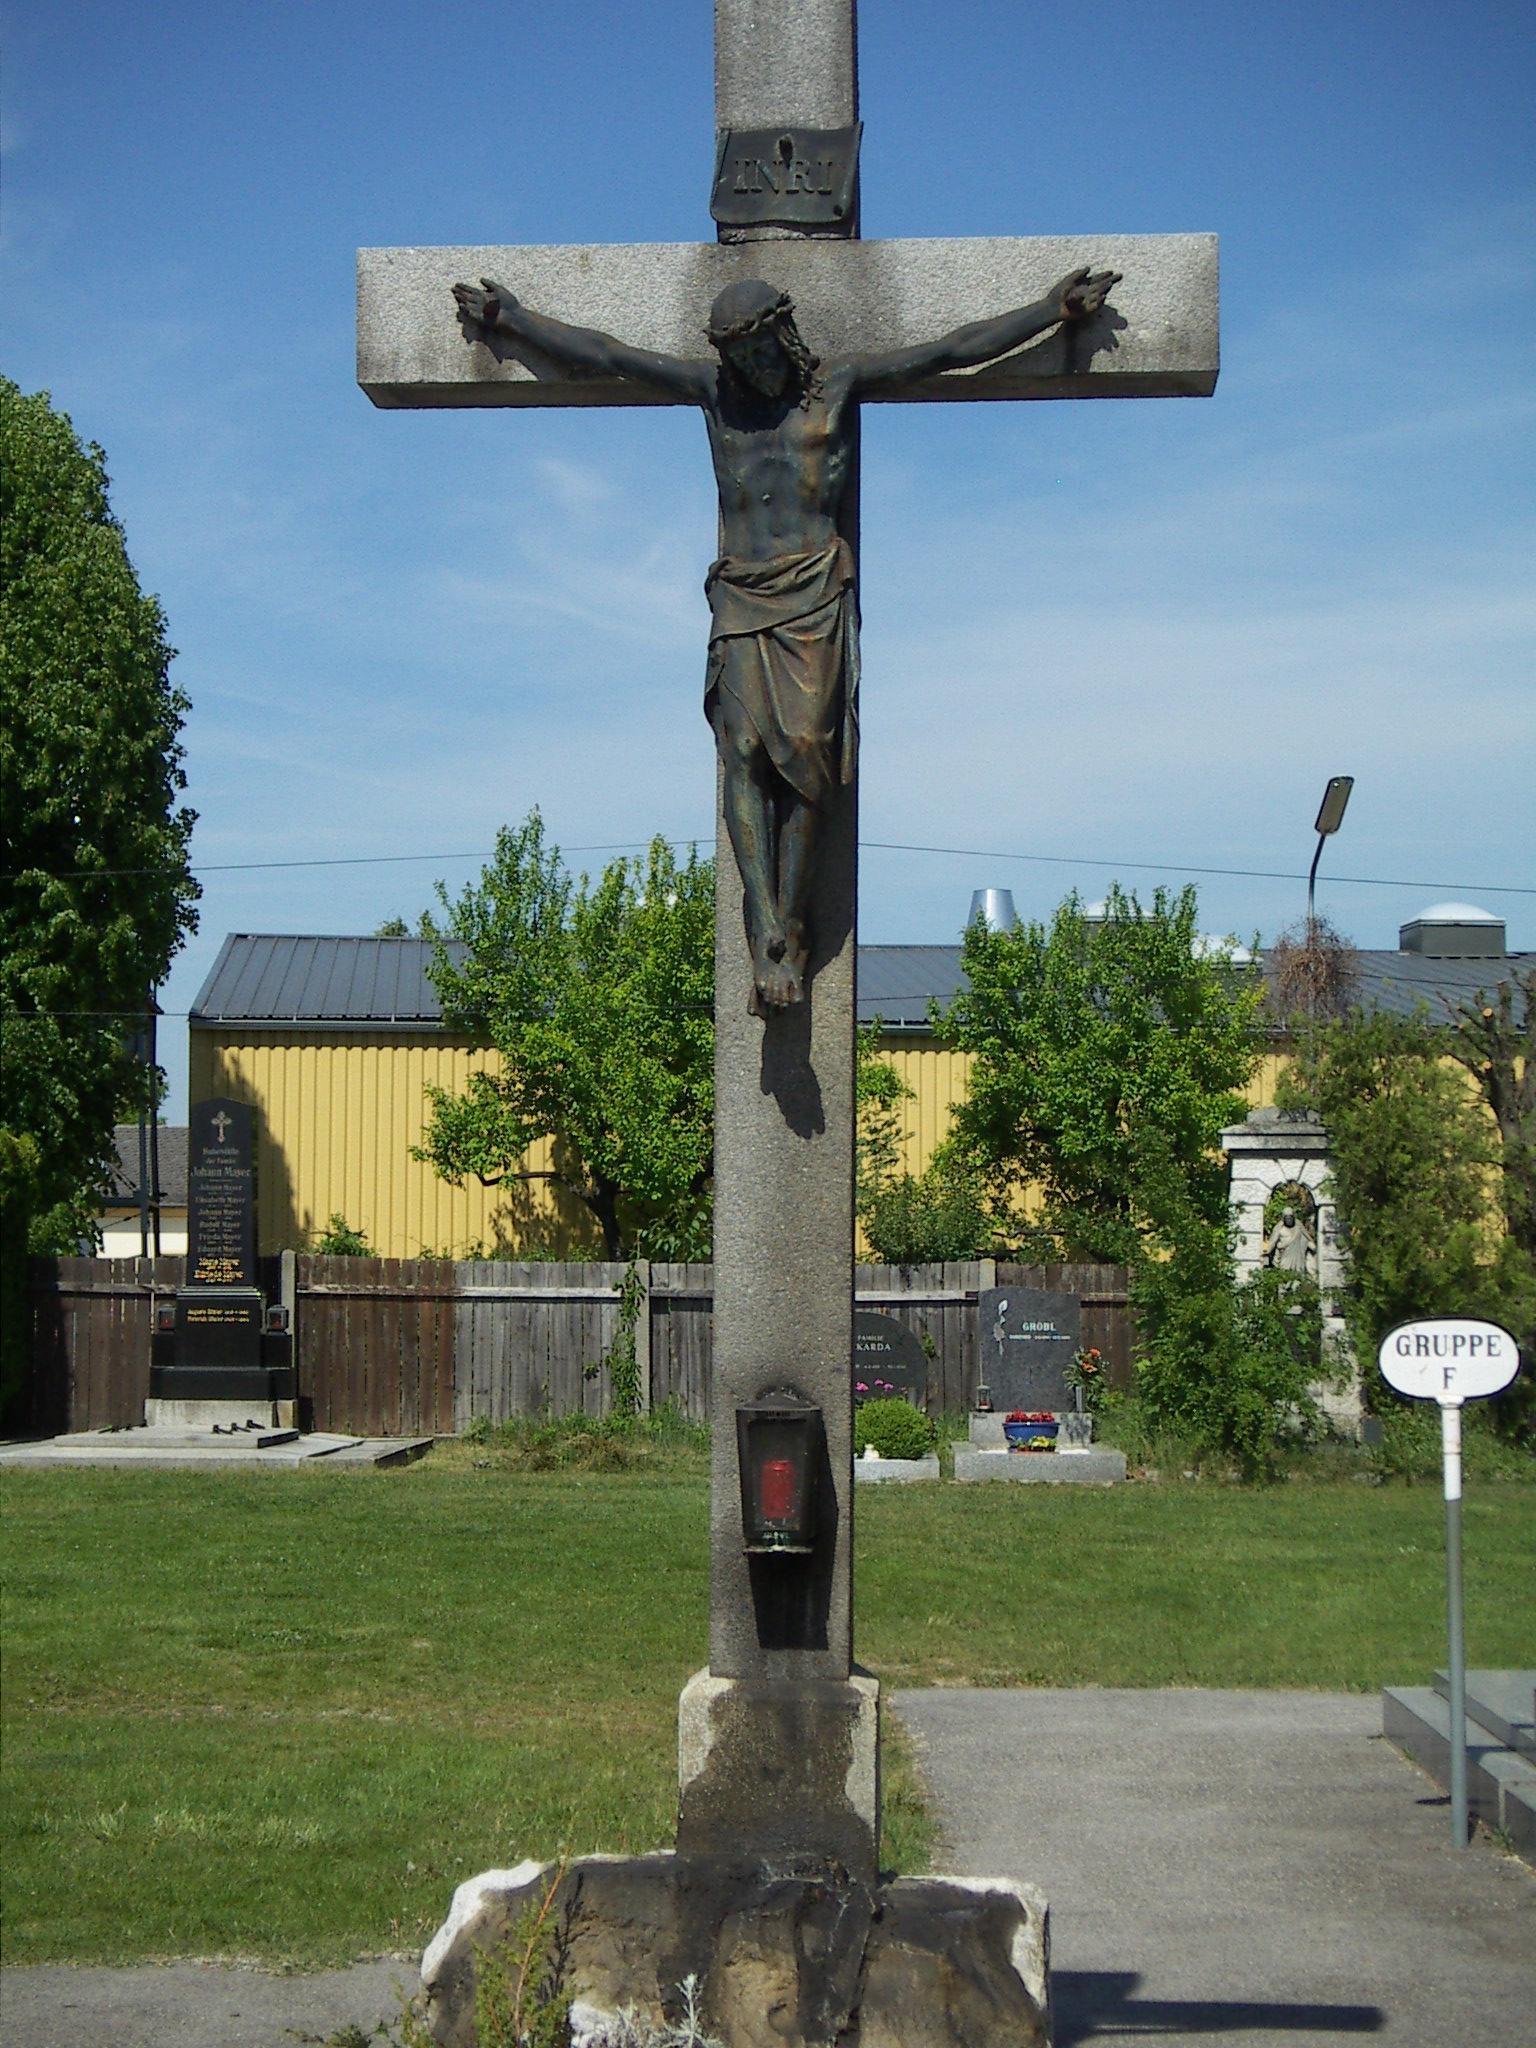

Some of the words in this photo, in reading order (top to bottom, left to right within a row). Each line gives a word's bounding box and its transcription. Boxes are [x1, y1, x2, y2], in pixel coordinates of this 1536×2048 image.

[733, 158, 833, 195] INRI
[190, 1166, 222, 1177] Johann
[224, 1166, 251, 1178] Mayer
[1395, 1333, 1502, 1358] GRUPPE
[1443, 1366, 1457, 1390] F
